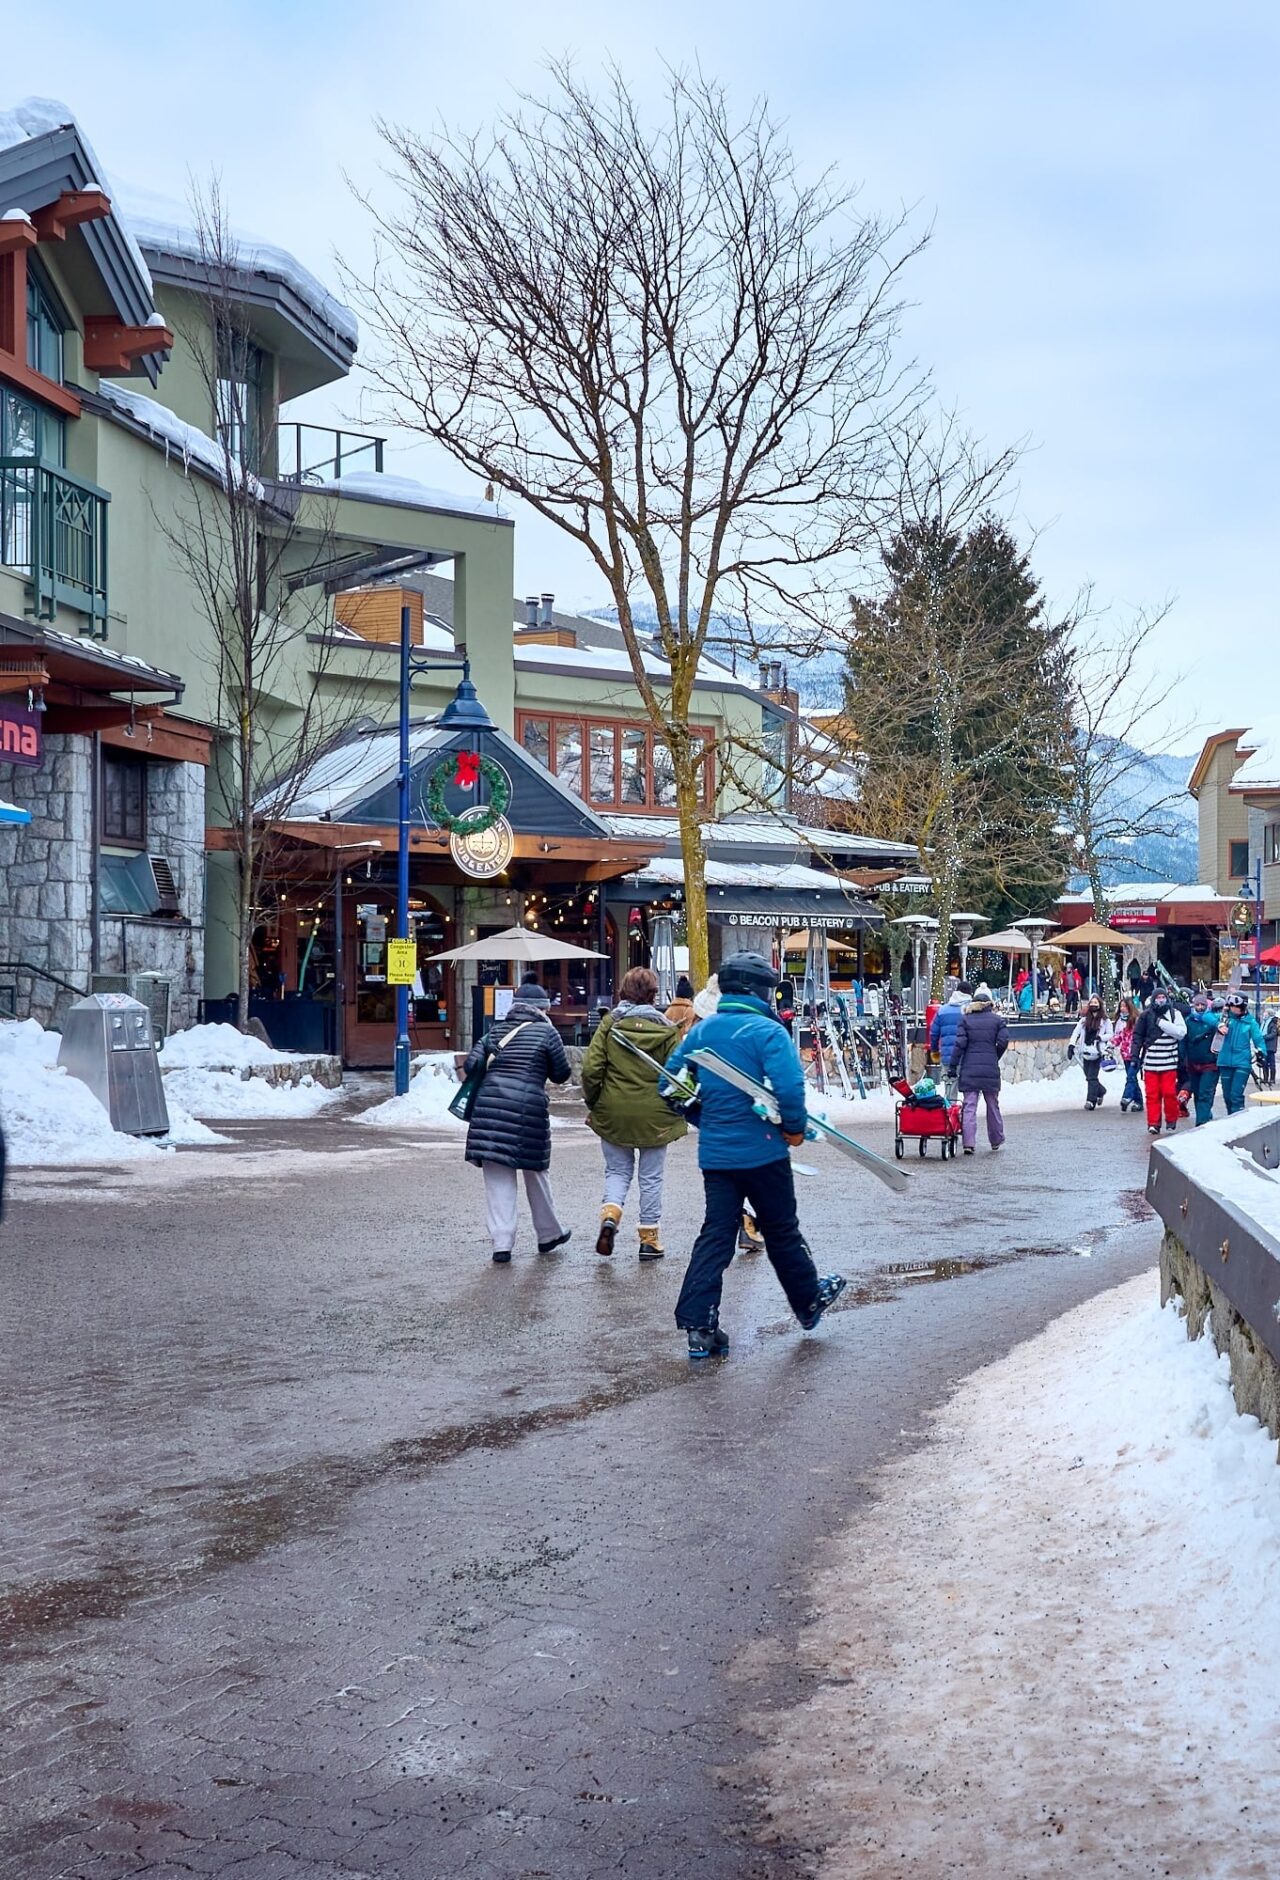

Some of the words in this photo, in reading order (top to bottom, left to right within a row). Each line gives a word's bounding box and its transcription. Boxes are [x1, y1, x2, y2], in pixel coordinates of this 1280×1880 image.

[0, 720, 37, 756] na
[900, 883, 930, 893] EATERY
[739, 915, 779, 926] BEACON
[781, 916, 800, 927] PUB
[801, 917, 809, 927] &
[810, 917, 845, 928] EATERY
